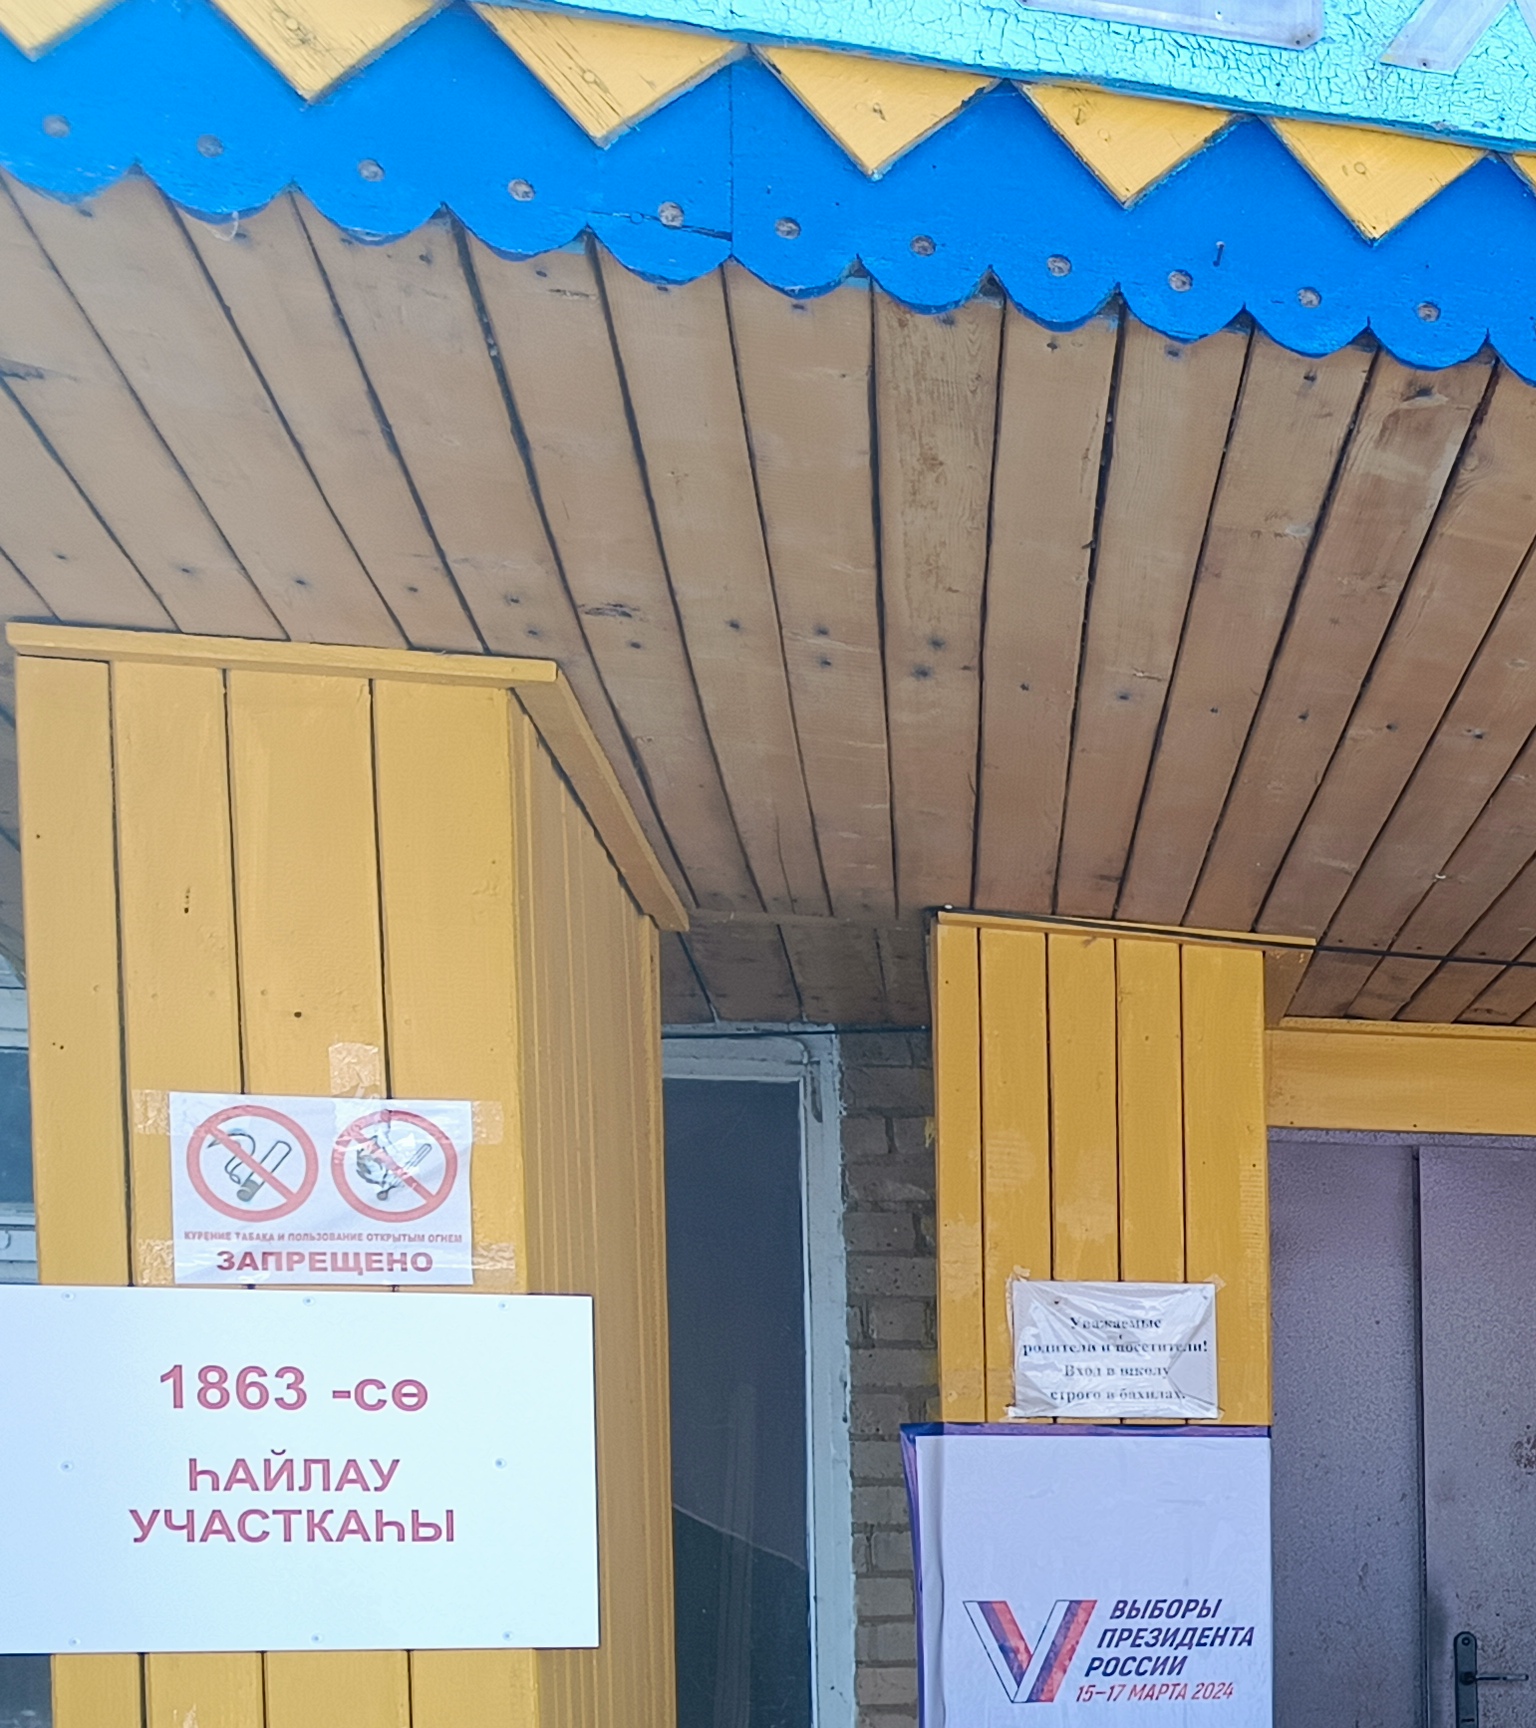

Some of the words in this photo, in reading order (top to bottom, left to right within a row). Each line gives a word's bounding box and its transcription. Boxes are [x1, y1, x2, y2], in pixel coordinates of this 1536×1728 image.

[185, 1231, 231, 1241] КУРЕНИЕ
[236, 1232, 274, 1242] ТАБАКА
[278, 1233, 284, 1241] И
[288, 1233, 363, 1242] ПОЛЬЗОВАНИЕ
[366, 1233, 425, 1243] ОТКРЫТЫМ
[428, 1234, 462, 1243] ОГНЕМ
[217, 1251, 433, 1275] ЗАПРЕЩЕНО
[1064, 1365, 1101, 1376] Вход
[1120, 1367, 1169, 1378] школу
[160, 1365, 307, 1410] 1863
[1110, 1599, 1222, 1619] ВЫБОРЫ
[1098, 1627, 1254, 1650] ПРЕЗИДЕНТА
[1085, 1656, 1187, 1677] РОССИИ
[1127, 1683, 1190, 1702] МАРТА
[1192, 1682, 1234, 1700] 2024
